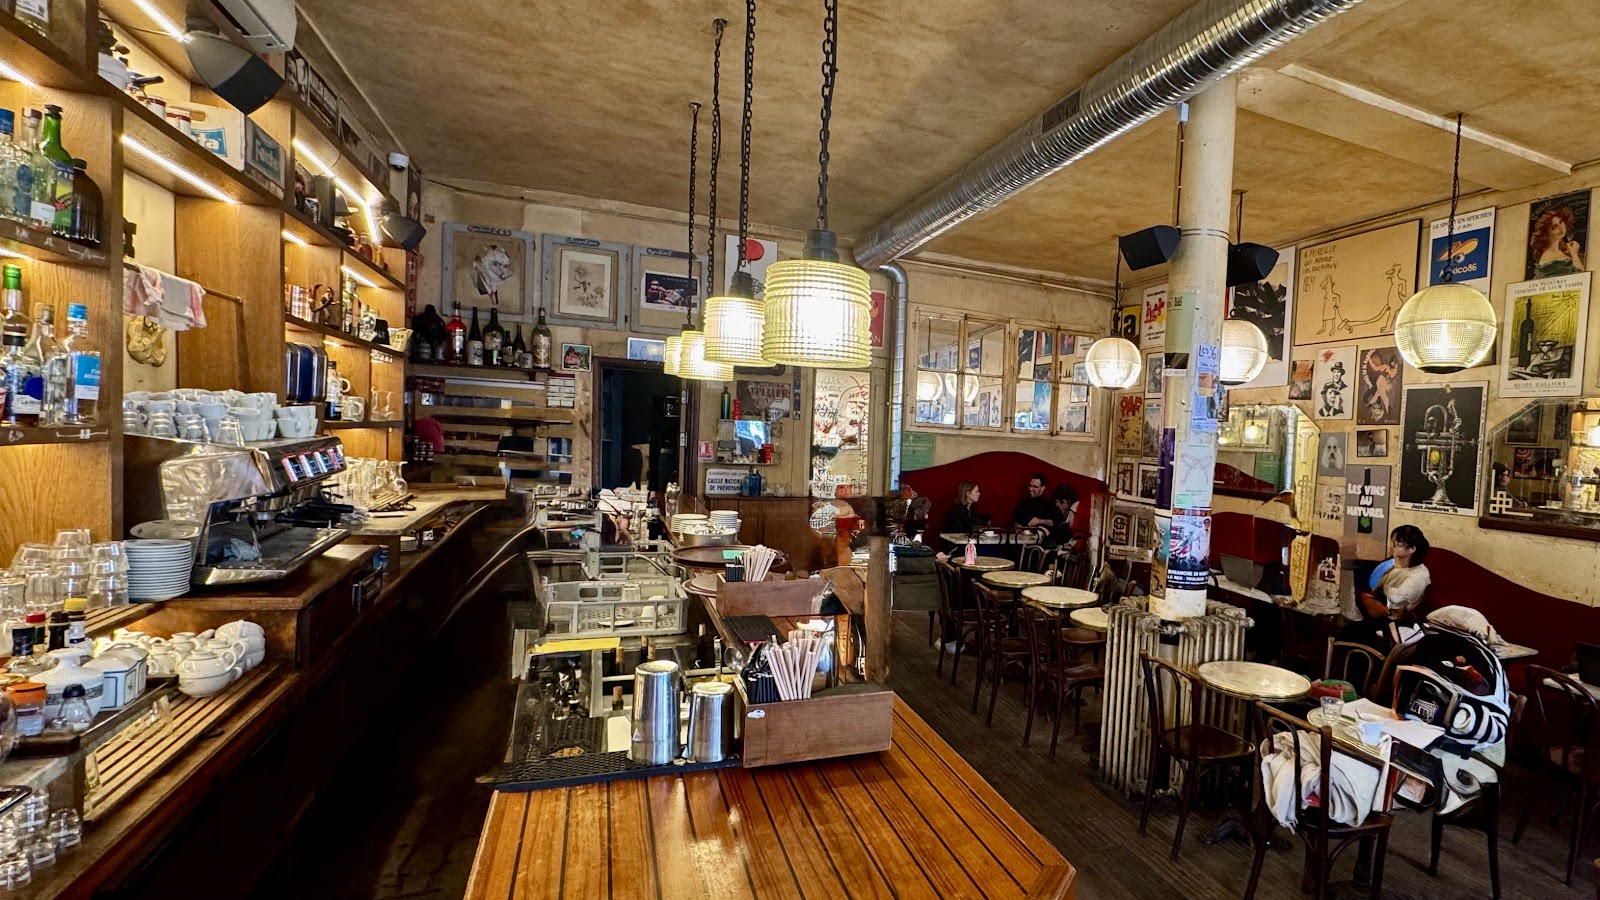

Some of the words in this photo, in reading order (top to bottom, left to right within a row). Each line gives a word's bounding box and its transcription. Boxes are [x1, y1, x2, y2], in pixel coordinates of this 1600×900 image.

[1466, 212, 1493, 222] AFFICHES
[1315, 256, 1334, 264] ADORE
[1540, 279, 1567, 287] PEINTRES
[1565, 281, 1583, 289] TEMPS
[750, 387, 789, 398] TELLIER
[1348, 483, 1362, 495] LES
[1364, 485, 1386, 497] VINS
[1360, 496, 1373, 506] AU
[1347, 506, 1385, 518] NATUREL
